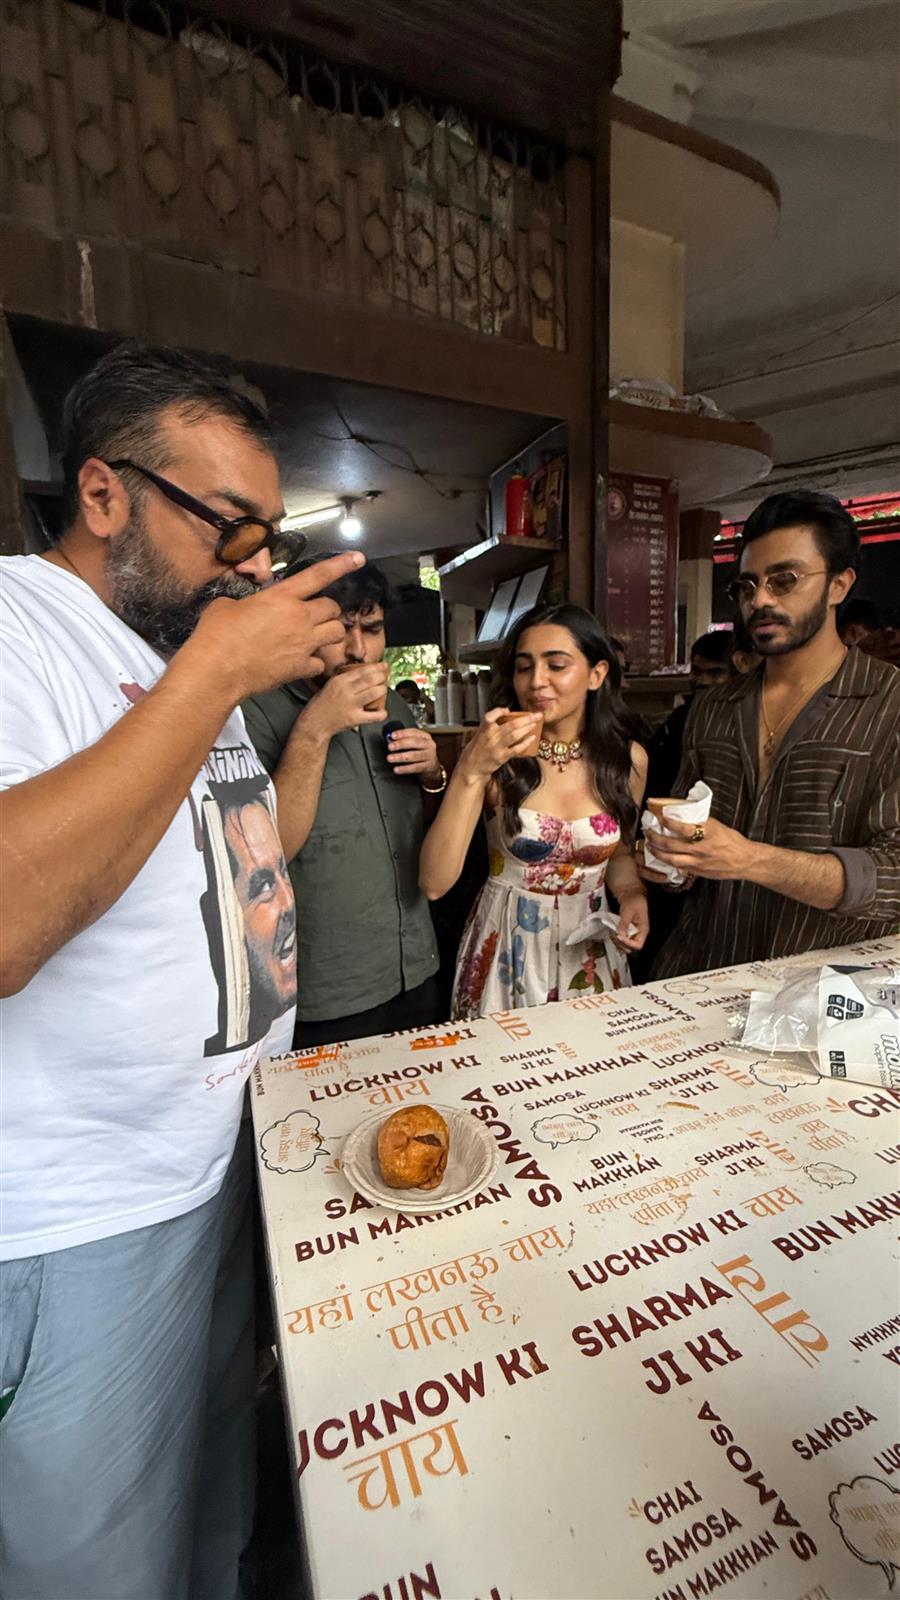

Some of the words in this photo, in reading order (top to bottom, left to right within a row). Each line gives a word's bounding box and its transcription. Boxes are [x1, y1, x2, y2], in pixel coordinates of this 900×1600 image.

[606, 1006, 640, 1018] CHAI
[607, 1010, 659, 1028] SAMOSA
[640, 990, 696, 1022] SAMOSA
[492, 1077, 540, 1096] BUN
[545, 1050, 649, 1088] MAKKHAN
[499, 1047, 556, 1063] SHARMA
[310, 1060, 443, 1102] LUCKNOW
[450, 1054, 482, 1070] KI
[648, 1067, 716, 1091] SHARMA
[680, 1085, 697, 1099] JI
[699, 1081, 719, 1094] KI
[524, 1089, 586, 1111] SAMOSA
[573, 1092, 634, 1114] LUCKNOW
[635, 1089, 652, 1098] KI
[590, 1150, 629, 1171] BUN
[694, 1139, 760, 1167] SHARMA
[725, 1162, 746, 1177] JI
[743, 1155, 766, 1169] KI
[573, 1157, 662, 1193] MAKKHAN
[740, 1185, 804, 1219] चाय
[294, 1226, 360, 1262] BUN
[568, 1222, 710, 1292] LUCKNOW
[708, 1209, 749, 1235] KI
[771, 1220, 842, 1262] BUN
[284, 1284, 354, 1336] यहां
[359, 1248, 500, 1314] लखनऊ
[499, 1225, 566, 1263] चाय
[385, 1304, 470, 1352] पीता
[470, 1283, 506, 1325] है
[571, 1276, 733, 1357] SHARMA
[495, 1341, 550, 1386] KI
[641, 1349, 693, 1395] JI
[684, 1327, 743, 1373] KI
[791, 1405, 879, 1460] SAMOSA
[342, 1418, 469, 1512] चाय
[697, 1400, 818, 1562] SAMOSA
[643, 1480, 703, 1525] CHAI
[645, 1507, 742, 1575] SAMOSA
[686, 1529, 780, 1600] MAKKHAN
